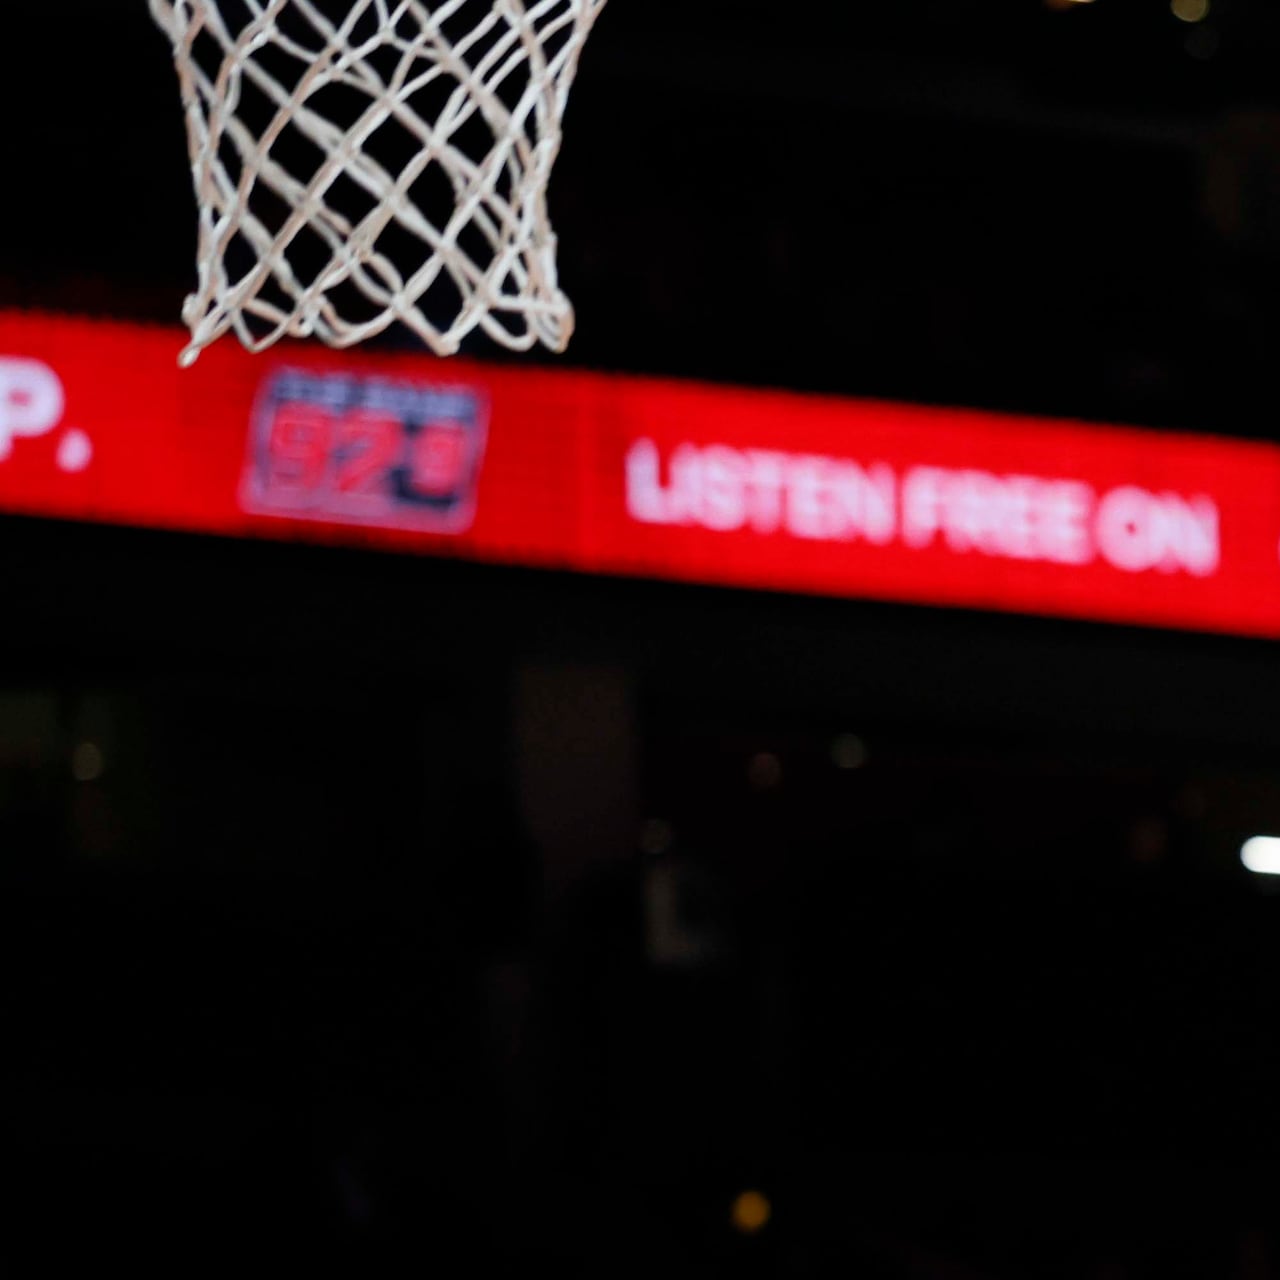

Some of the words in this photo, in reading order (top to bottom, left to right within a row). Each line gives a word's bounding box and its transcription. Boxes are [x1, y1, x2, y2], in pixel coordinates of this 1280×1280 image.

[625, 437, 896, 546] LISTEN
[902, 464, 1096, 566] FREE
[1096, 484, 1220, 577] ON
